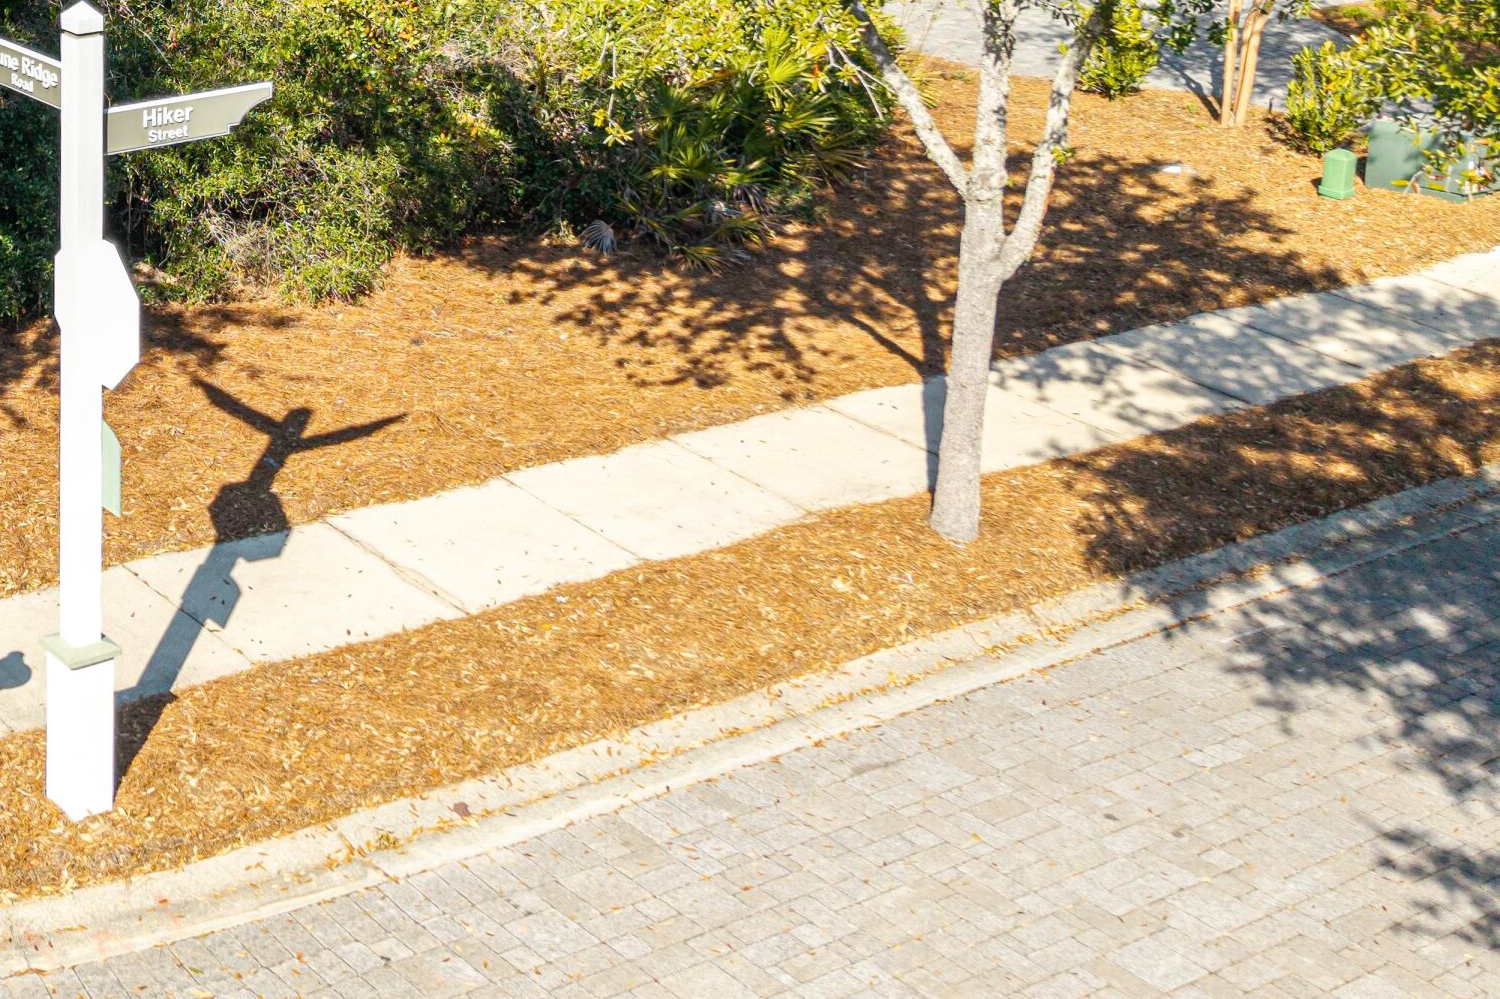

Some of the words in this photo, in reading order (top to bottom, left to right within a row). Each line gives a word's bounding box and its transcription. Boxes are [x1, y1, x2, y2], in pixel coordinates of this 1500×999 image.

[11, 72, 34, 93] Road
[21, 56, 58, 89] Ridge
[142, 106, 194, 129] Hiker
[148, 124, 189, 143] Street
